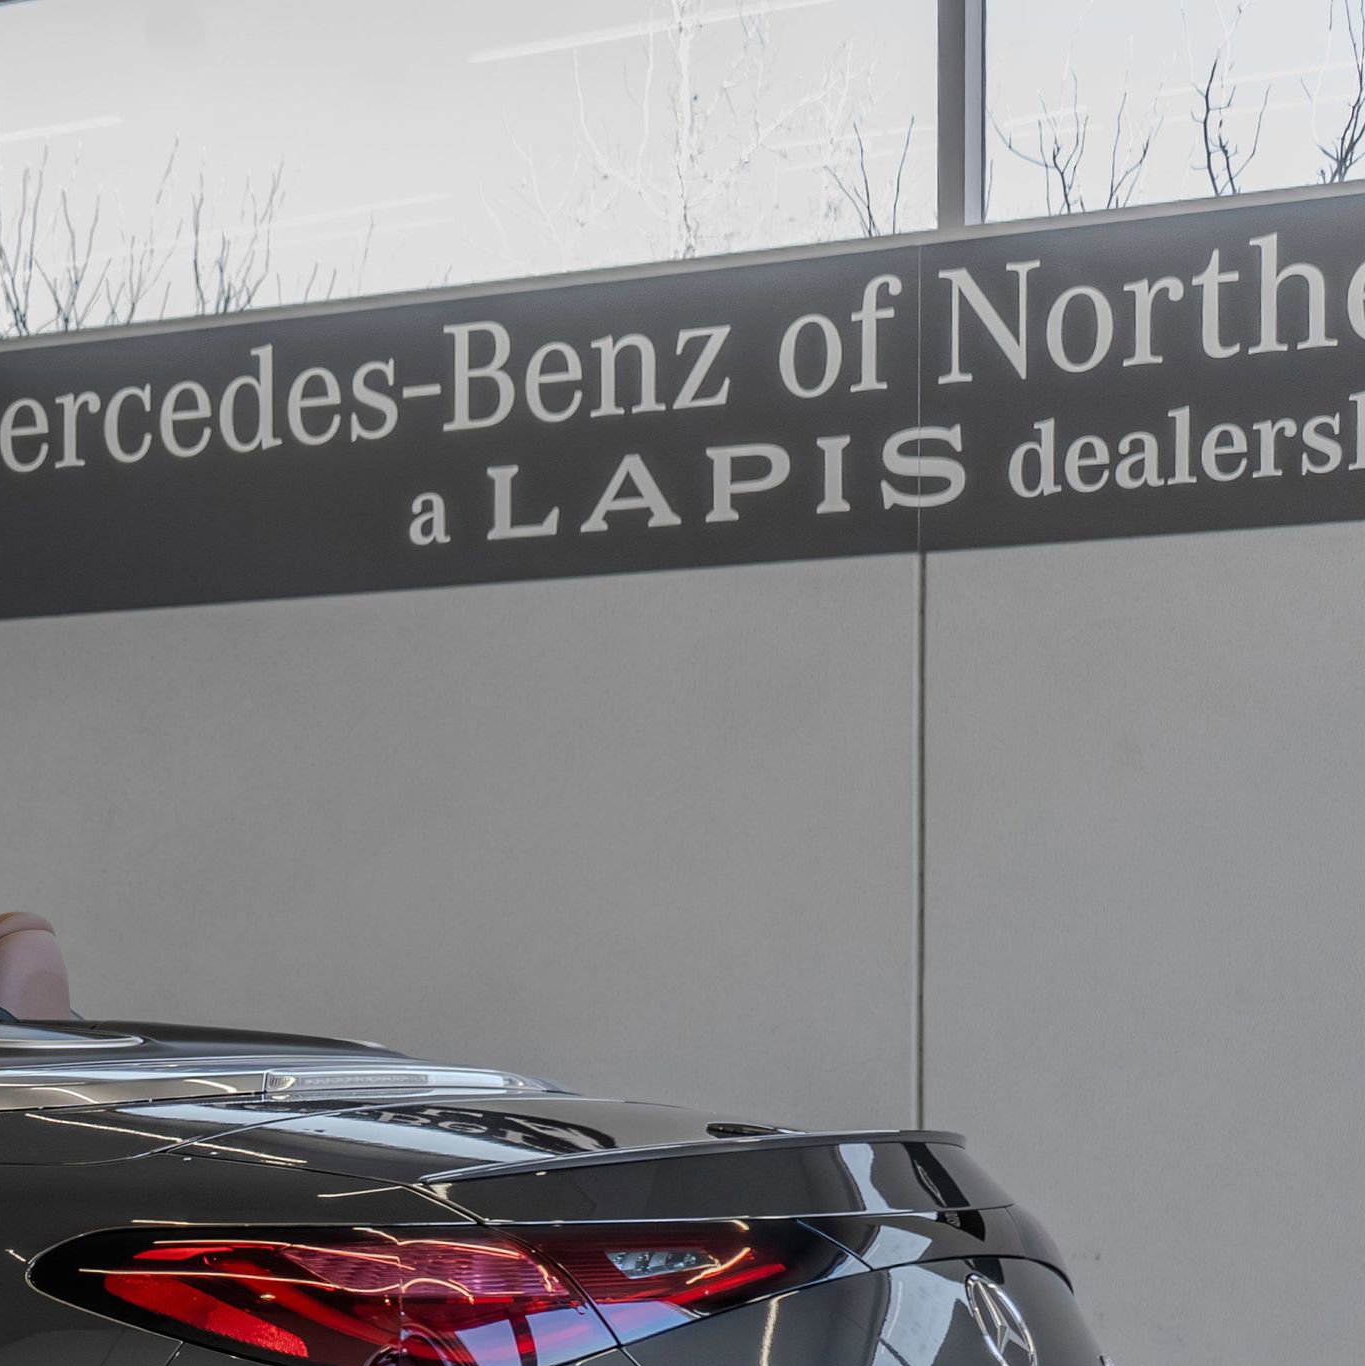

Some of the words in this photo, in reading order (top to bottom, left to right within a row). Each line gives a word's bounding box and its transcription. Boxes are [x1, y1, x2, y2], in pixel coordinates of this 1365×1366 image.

[778, 273, 903, 399] of
[409, 492, 451, 546] a
[486, 423, 966, 541] LAPIS
